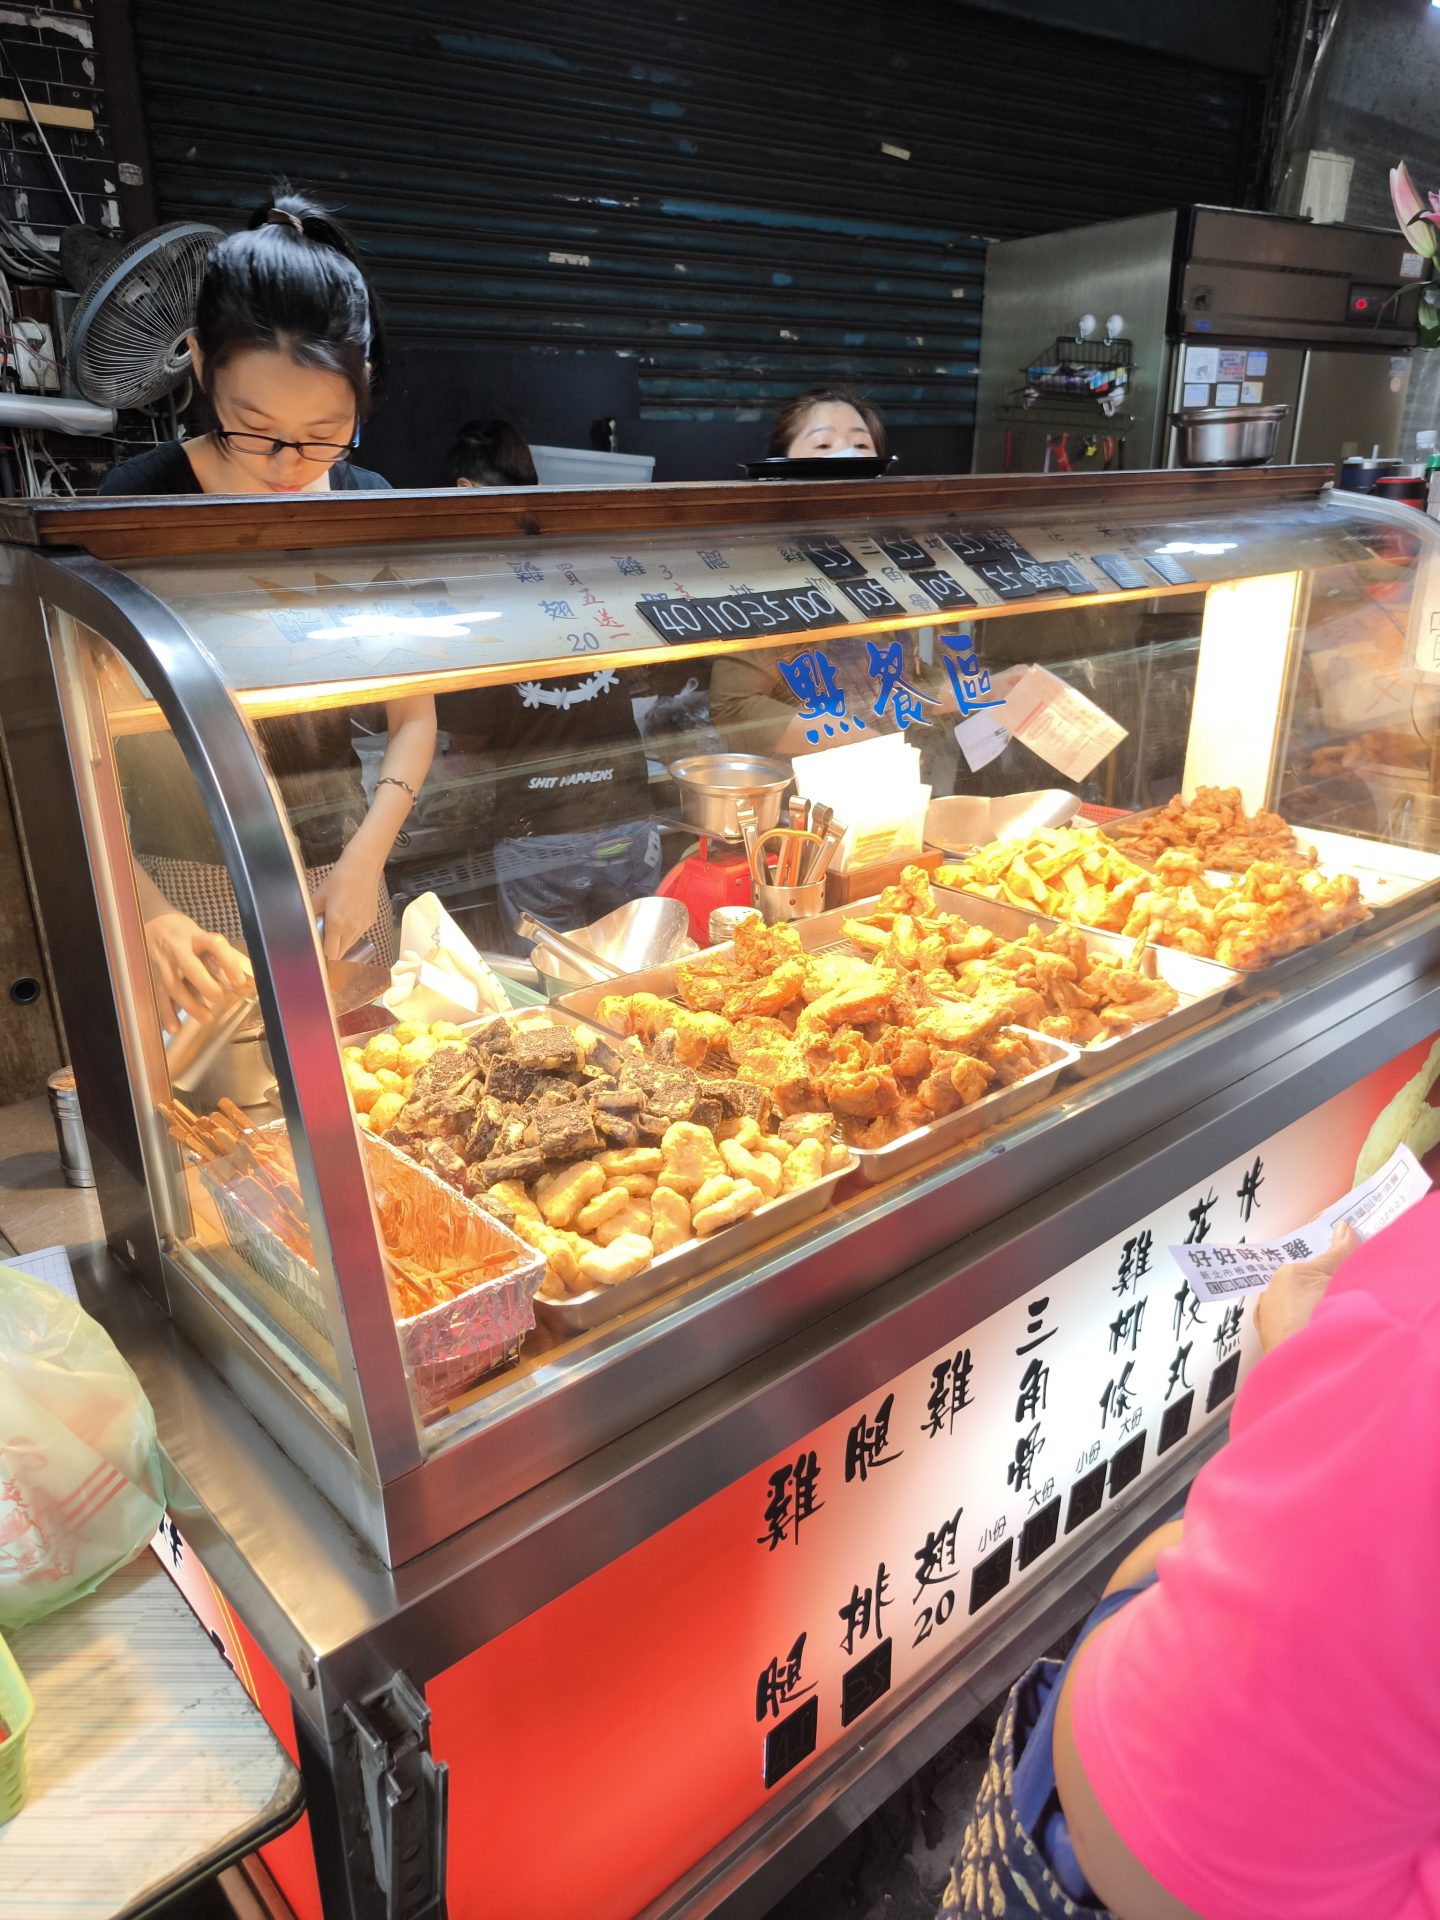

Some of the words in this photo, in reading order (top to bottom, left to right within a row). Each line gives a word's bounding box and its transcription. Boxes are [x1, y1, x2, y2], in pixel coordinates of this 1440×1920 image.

[883, 535, 925, 561] 55
[846, 578, 896, 611] 105
[920, 573, 966, 602] 105
[981, 565, 1023, 591] 55
[652, 604, 702, 637] 40
[786, 589, 837, 623] 100
[566, 632, 600, 652] 20
[777, 633, 1007, 745] 點餐區
[528, 776, 557, 789] SHIT
[559, 768, 615, 788] HAPPENS
[1188, 1238, 1313, 1268] 好好味炸雞
[1099, 1229, 1154, 1430] 雞柳條
[1006, 1296, 1060, 1493] 三角骨
[1028, 1475, 1056, 1515] 大份
[978, 1515, 1007, 1553] 小份
[911, 1589, 956, 1649] 20
